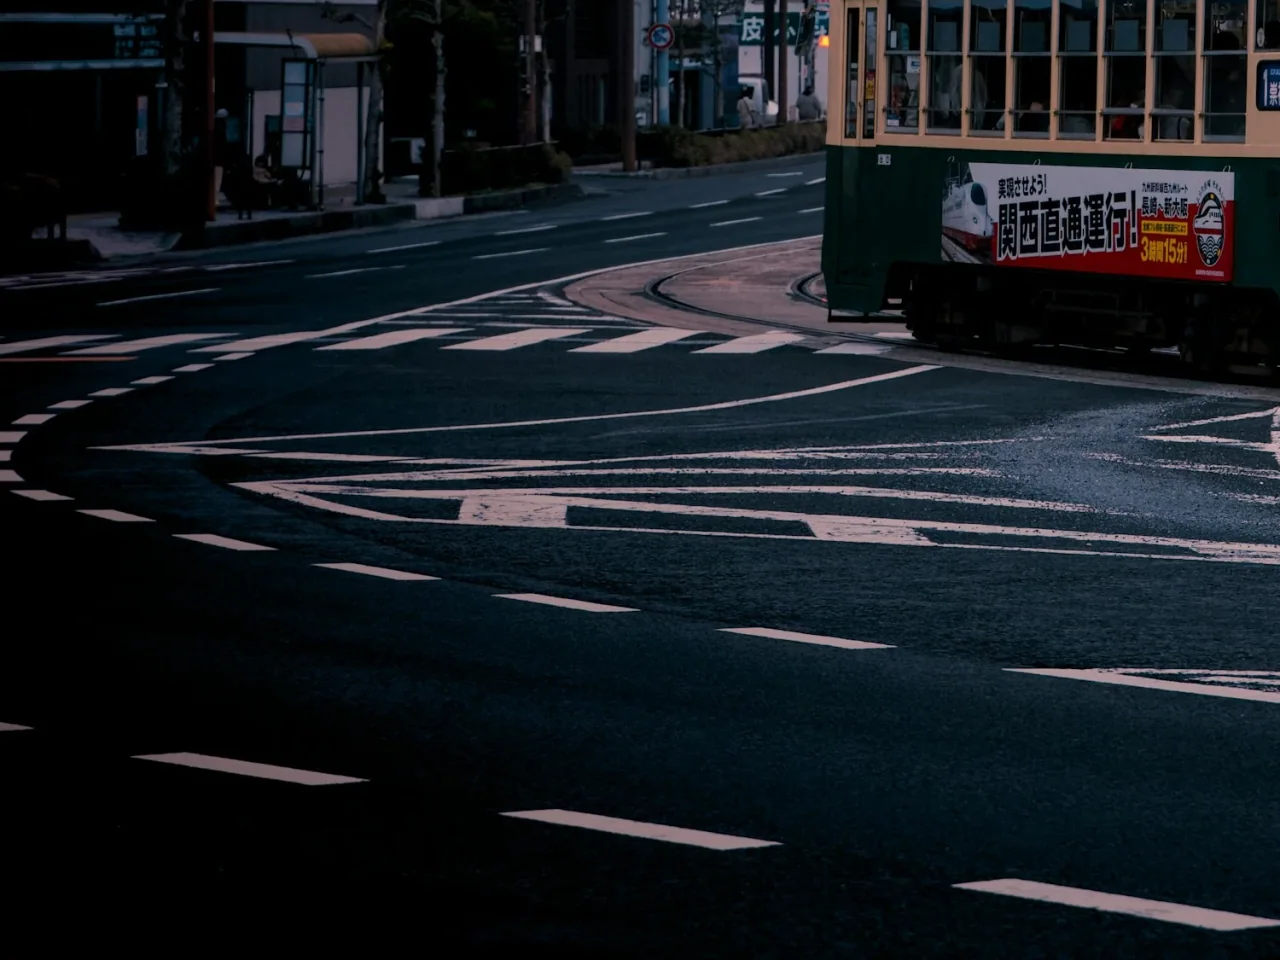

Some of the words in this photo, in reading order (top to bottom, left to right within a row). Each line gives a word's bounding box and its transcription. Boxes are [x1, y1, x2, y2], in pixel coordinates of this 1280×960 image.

[1262, 68, 1269, 107] 1
[998, 173, 1047, 199] 実現させよう!
[998, 190, 1138, 260] 関西直通運行!
